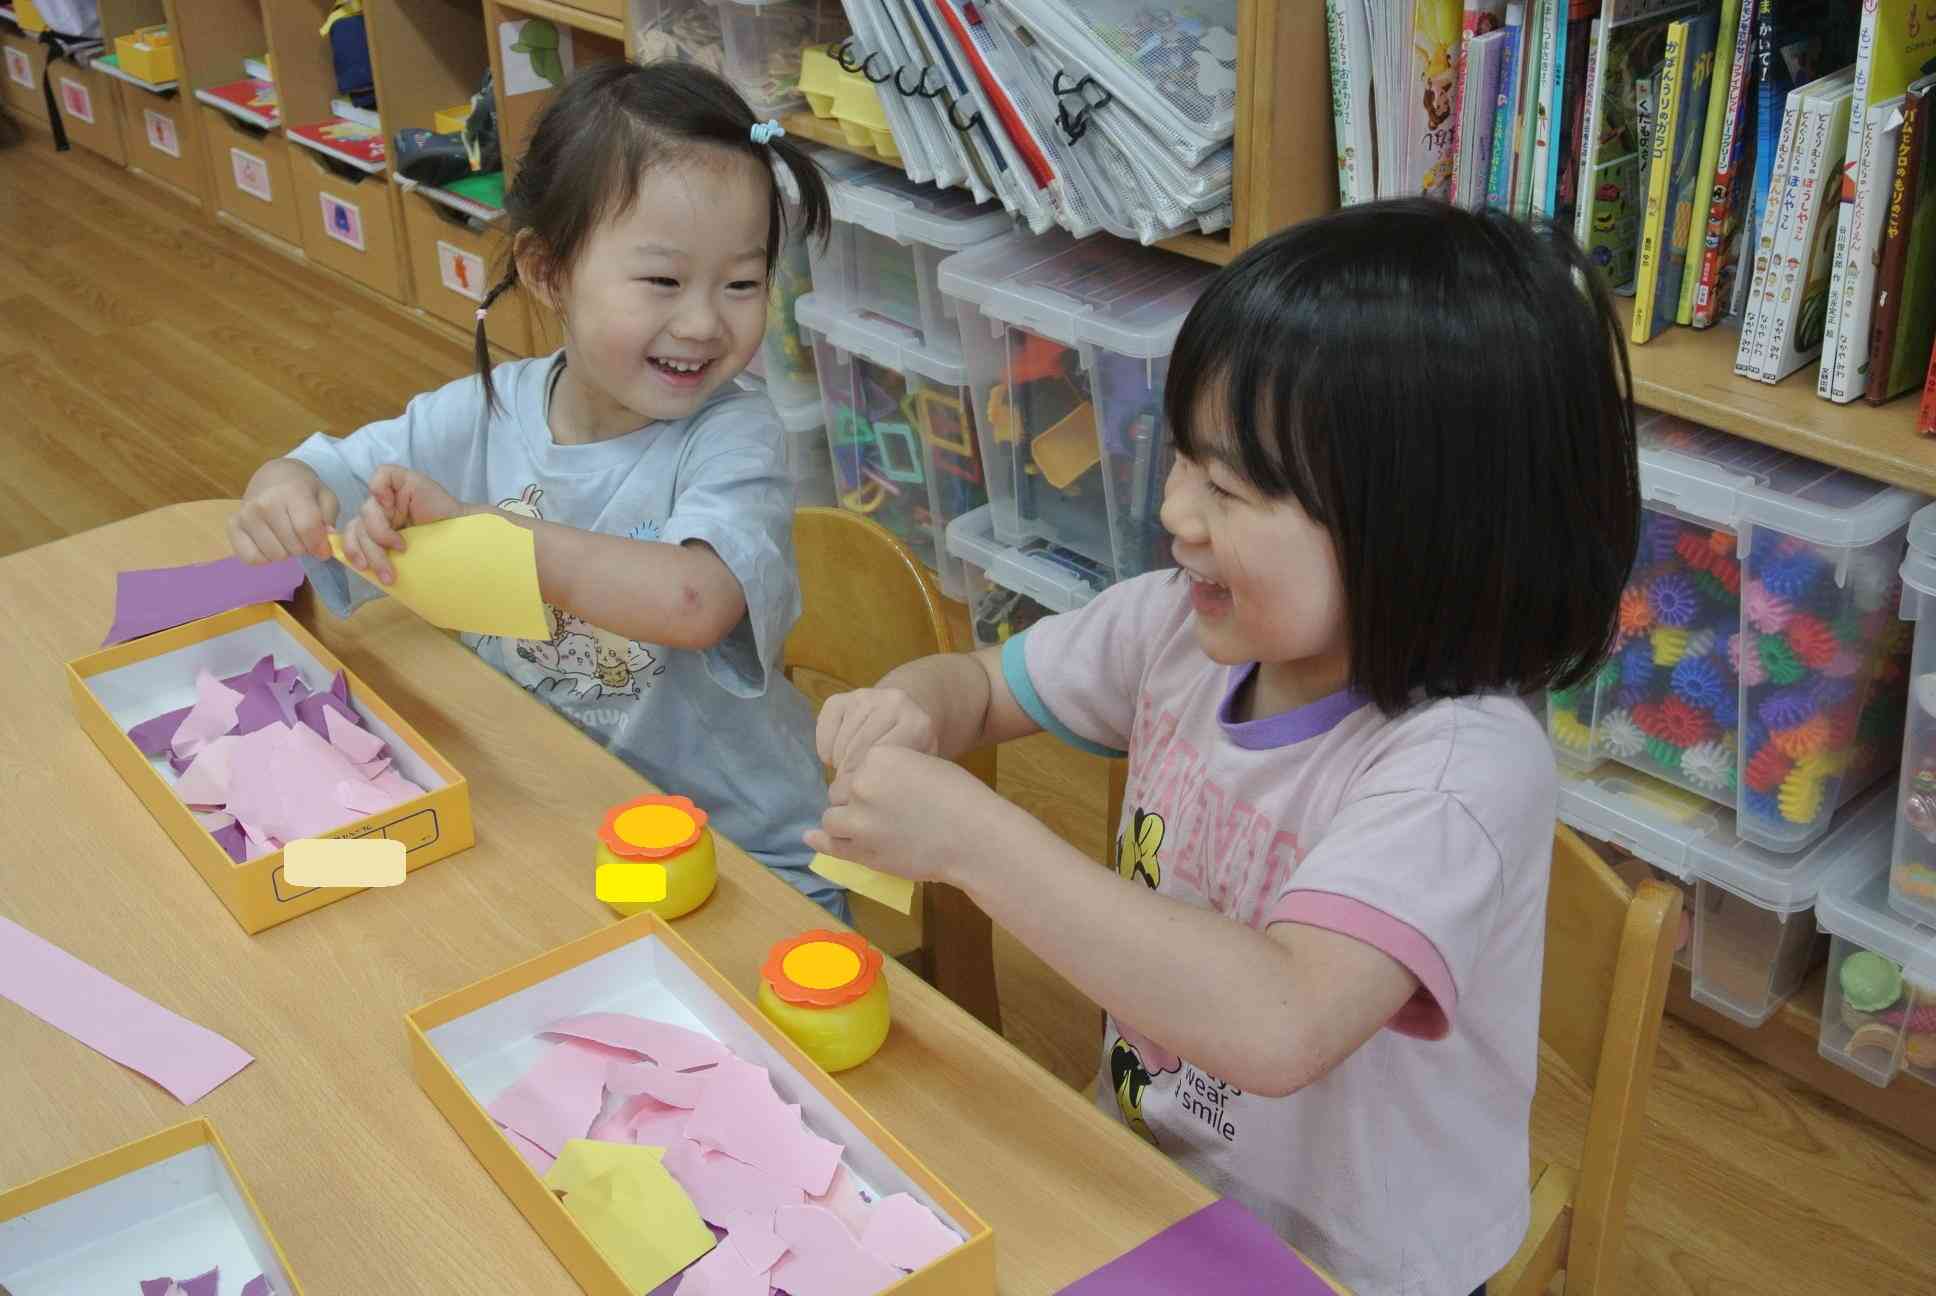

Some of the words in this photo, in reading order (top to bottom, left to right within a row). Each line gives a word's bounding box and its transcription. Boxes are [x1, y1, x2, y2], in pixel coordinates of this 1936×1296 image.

[1888, 110, 1918, 239] バムとケロのもりのこや
[1185, 1067, 1229, 1107] wear
[1182, 1091, 1235, 1142] smile
